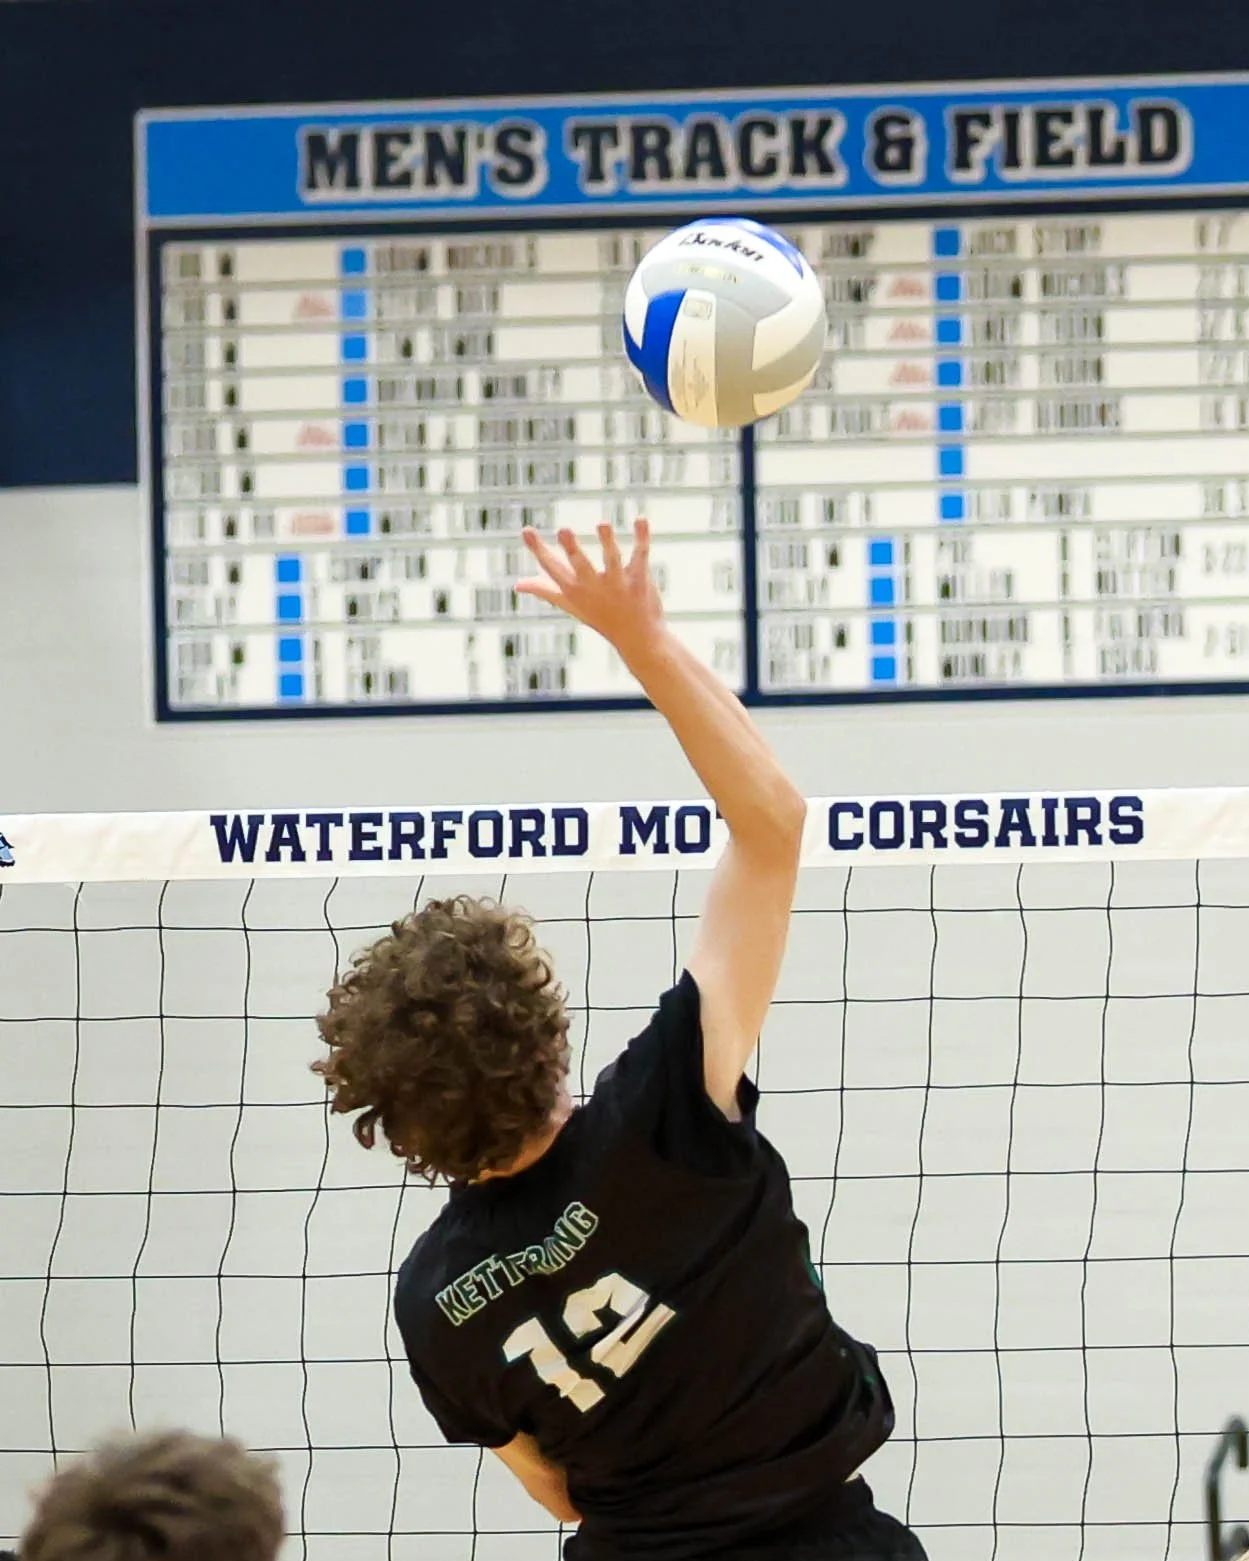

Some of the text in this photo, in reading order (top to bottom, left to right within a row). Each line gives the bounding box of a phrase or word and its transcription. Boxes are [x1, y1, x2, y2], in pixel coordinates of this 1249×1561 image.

[302, 102, 1188, 197] MEN'S TRACK & FIELD
[211, 796, 1144, 863] WATERFORD MO CORSAIRS
[502, 1272, 676, 1413] 12
